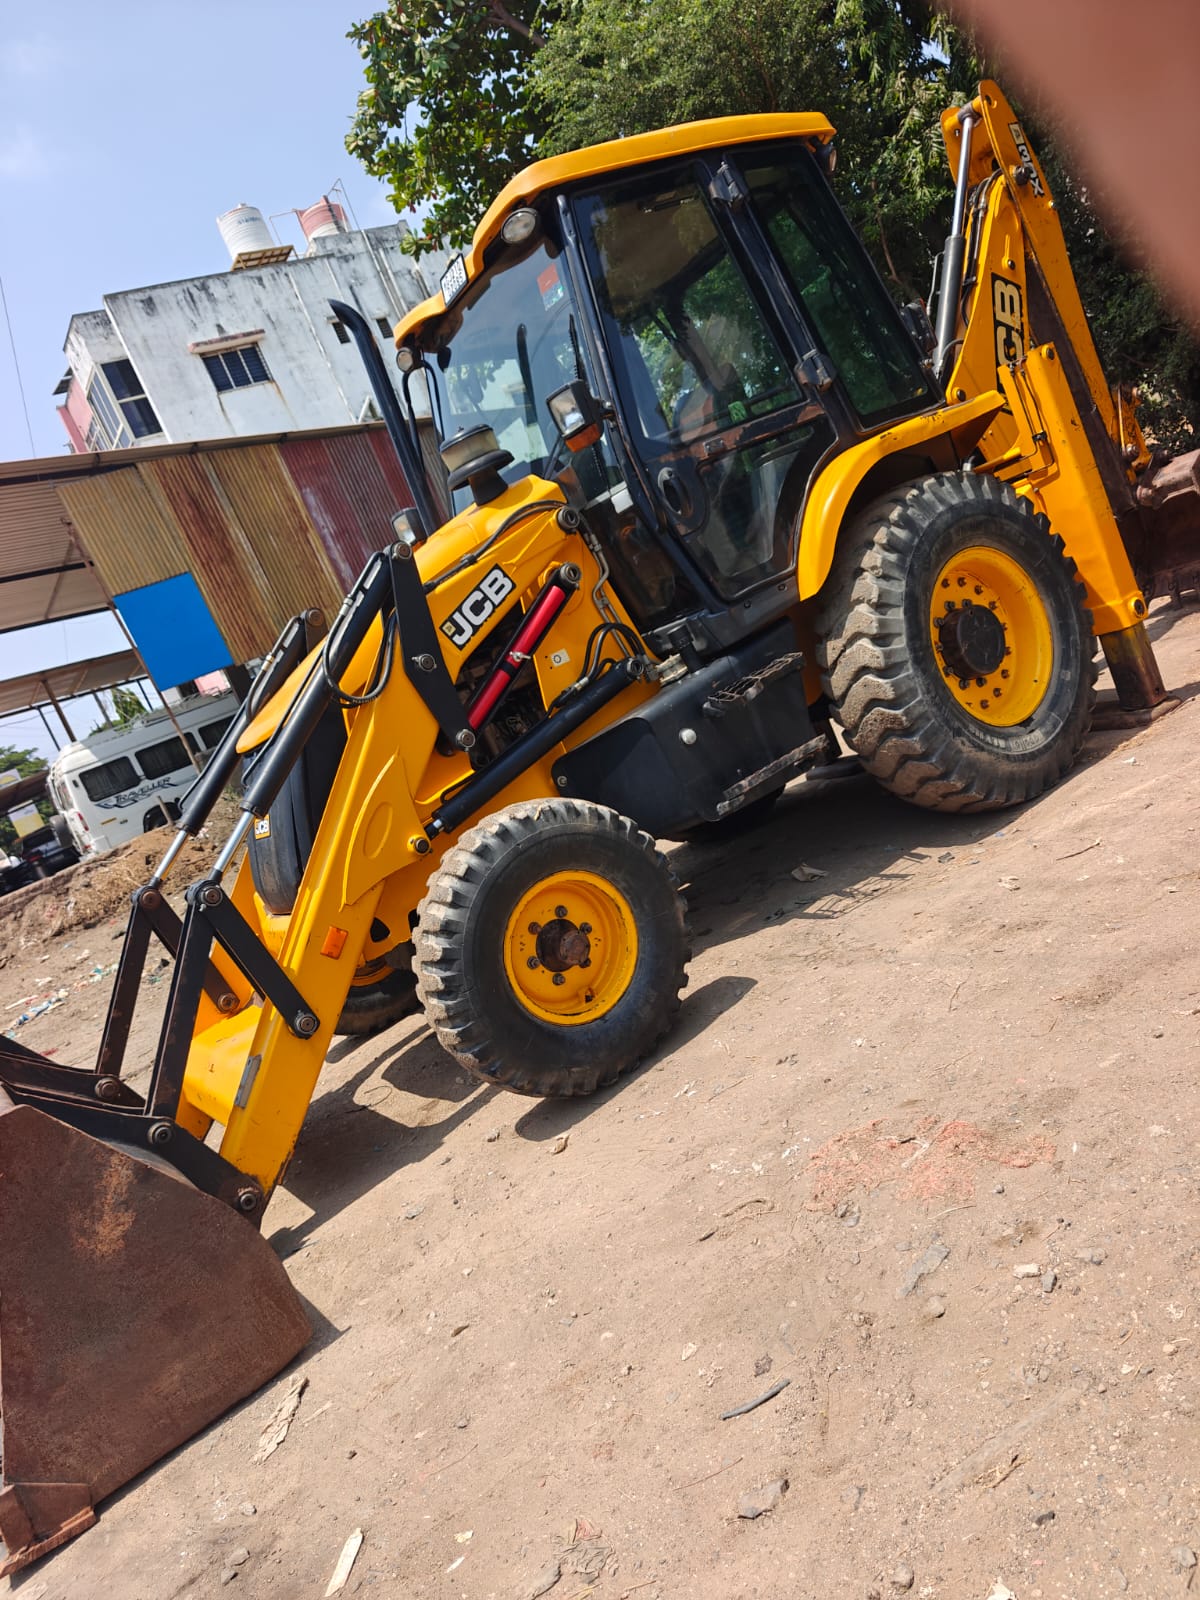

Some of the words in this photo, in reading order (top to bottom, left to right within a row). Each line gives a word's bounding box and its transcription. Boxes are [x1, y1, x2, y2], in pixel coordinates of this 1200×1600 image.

[994, 280, 1024, 370] CB
[451, 568, 513, 646] JCB
[113, 776, 174, 805] TRAVELLER
